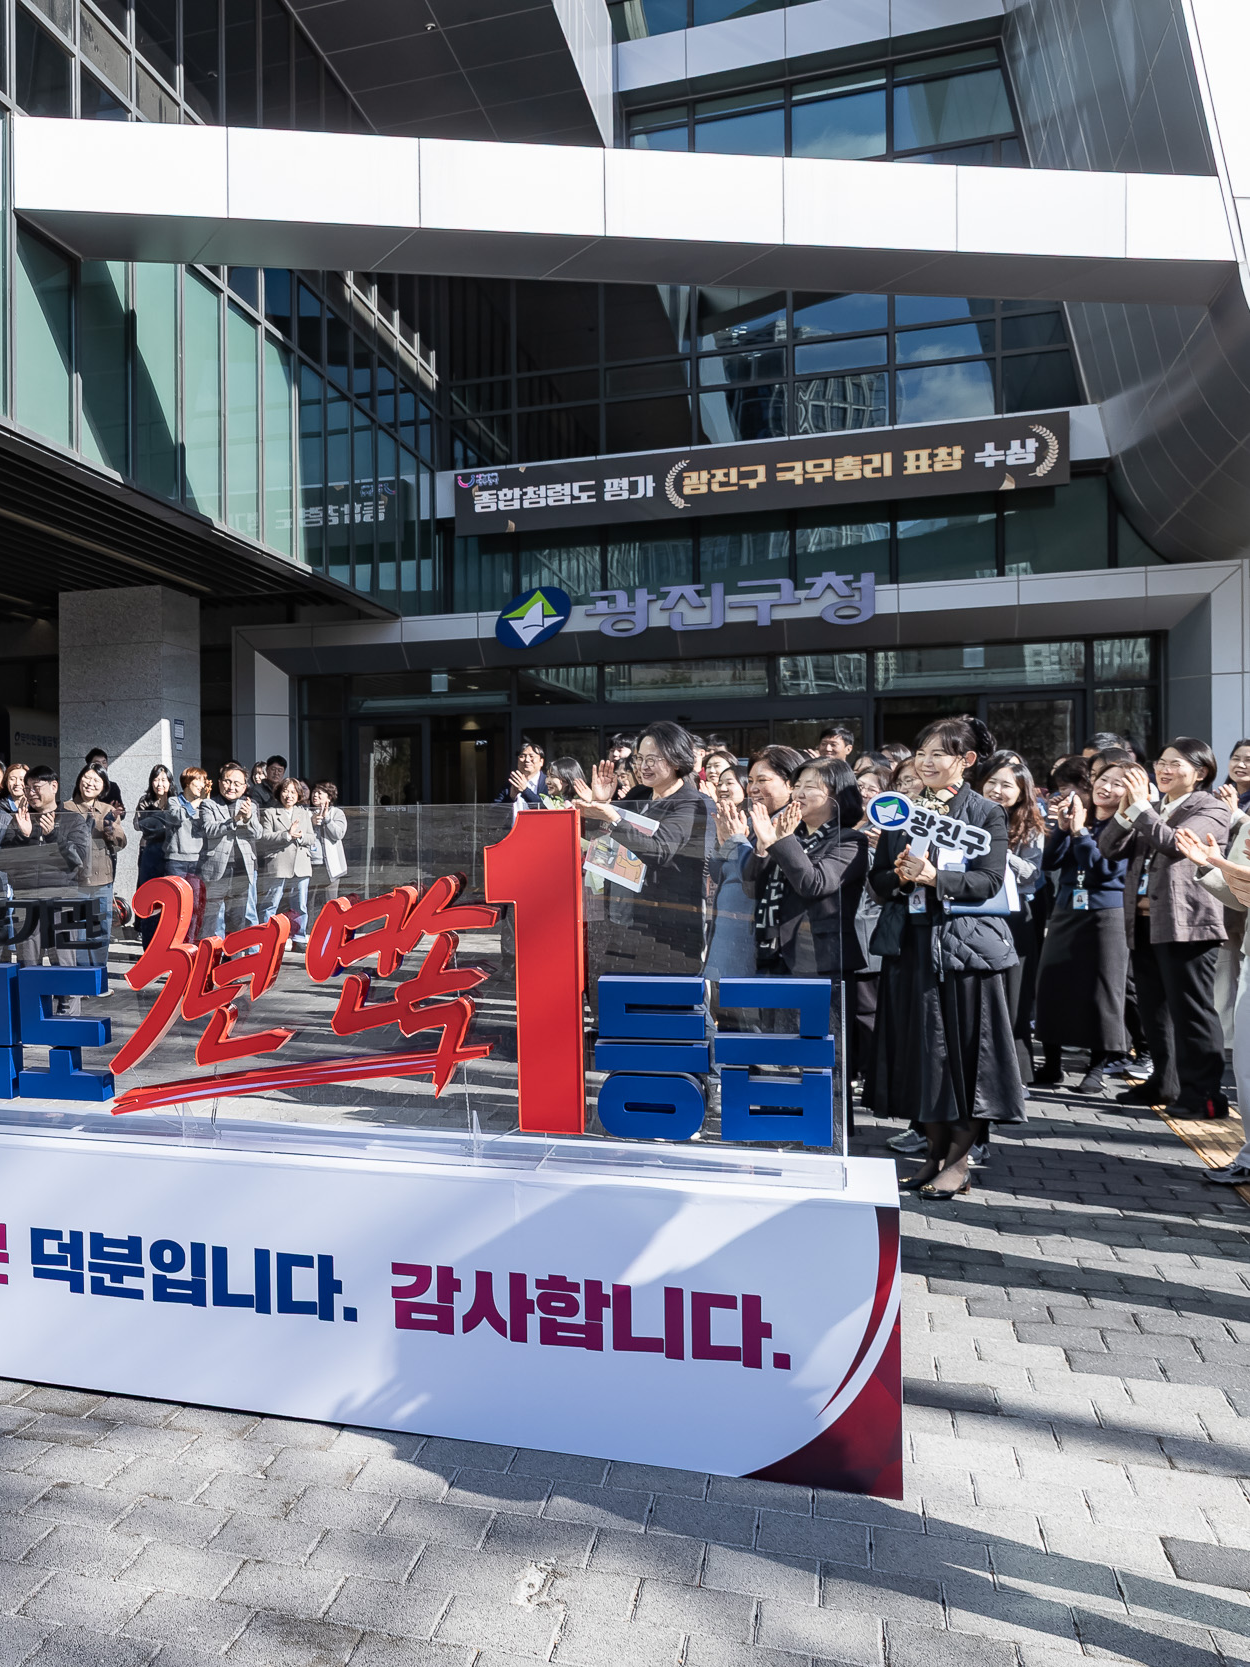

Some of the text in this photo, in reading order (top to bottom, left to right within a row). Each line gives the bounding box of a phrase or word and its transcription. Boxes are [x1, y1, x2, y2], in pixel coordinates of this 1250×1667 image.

[473, 480, 597, 514] 종합청렴도
[603, 474, 656, 502] 평가
[681, 463, 768, 496] 광진구
[775, 452, 894, 487] 국무총리
[903, 443, 966, 476] 표창
[973, 439, 1040, 469] 수상
[585, 571, 877, 638] 광진구청
[910, 810, 986, 855] 광진구
[30, 1226, 358, 1323] 덕분입니다.
[391, 1261, 792, 1371] 감사합니다.
